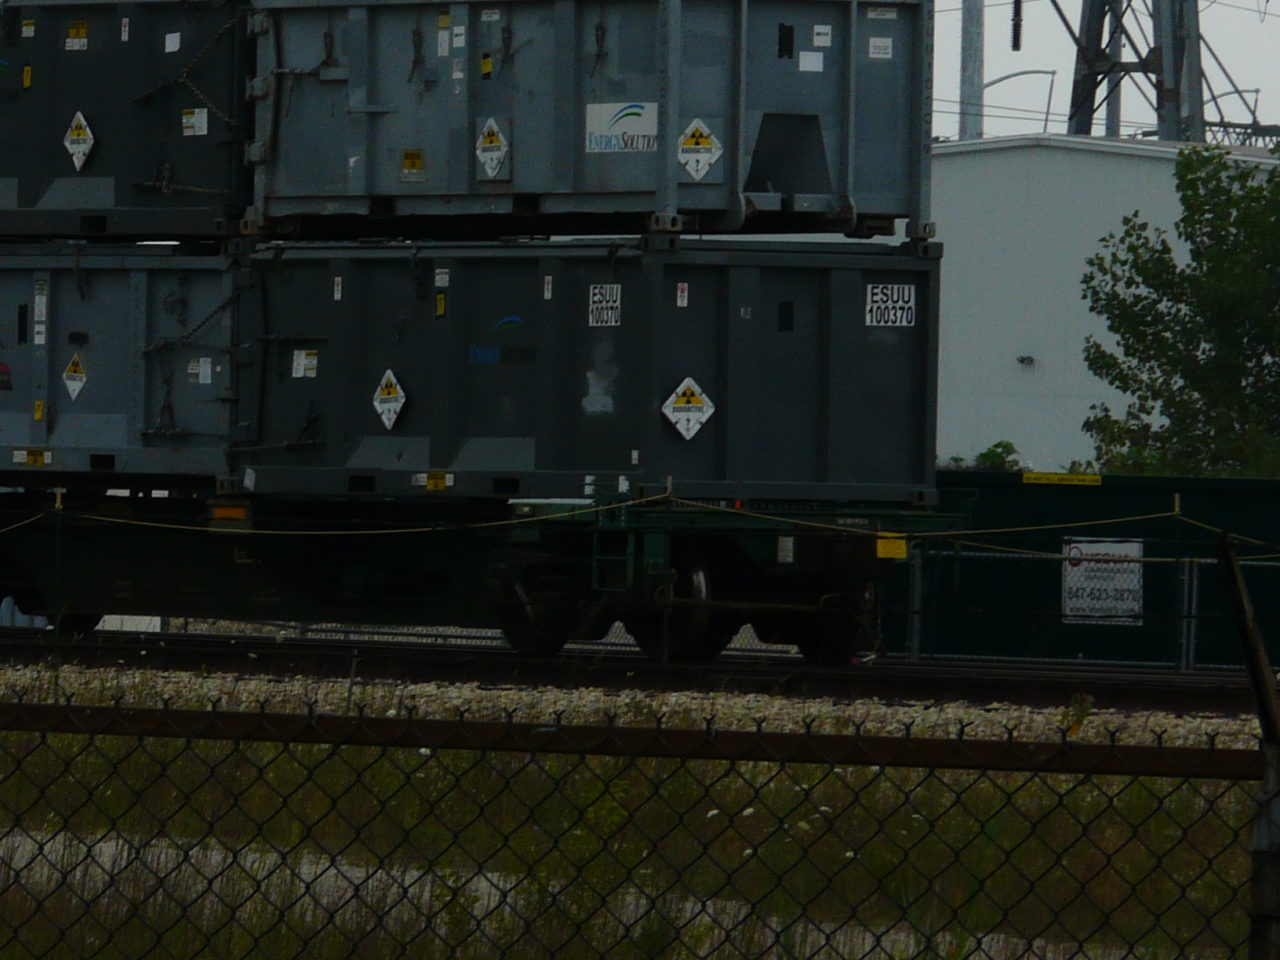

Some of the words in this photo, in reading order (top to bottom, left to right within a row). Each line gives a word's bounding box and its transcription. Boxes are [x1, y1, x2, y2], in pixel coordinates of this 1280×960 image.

[592, 286, 618, 304] ESUU
[871, 286, 911, 304] ESUU
[591, 306, 619, 325] 100370
[869, 305, 913, 325] 100370
